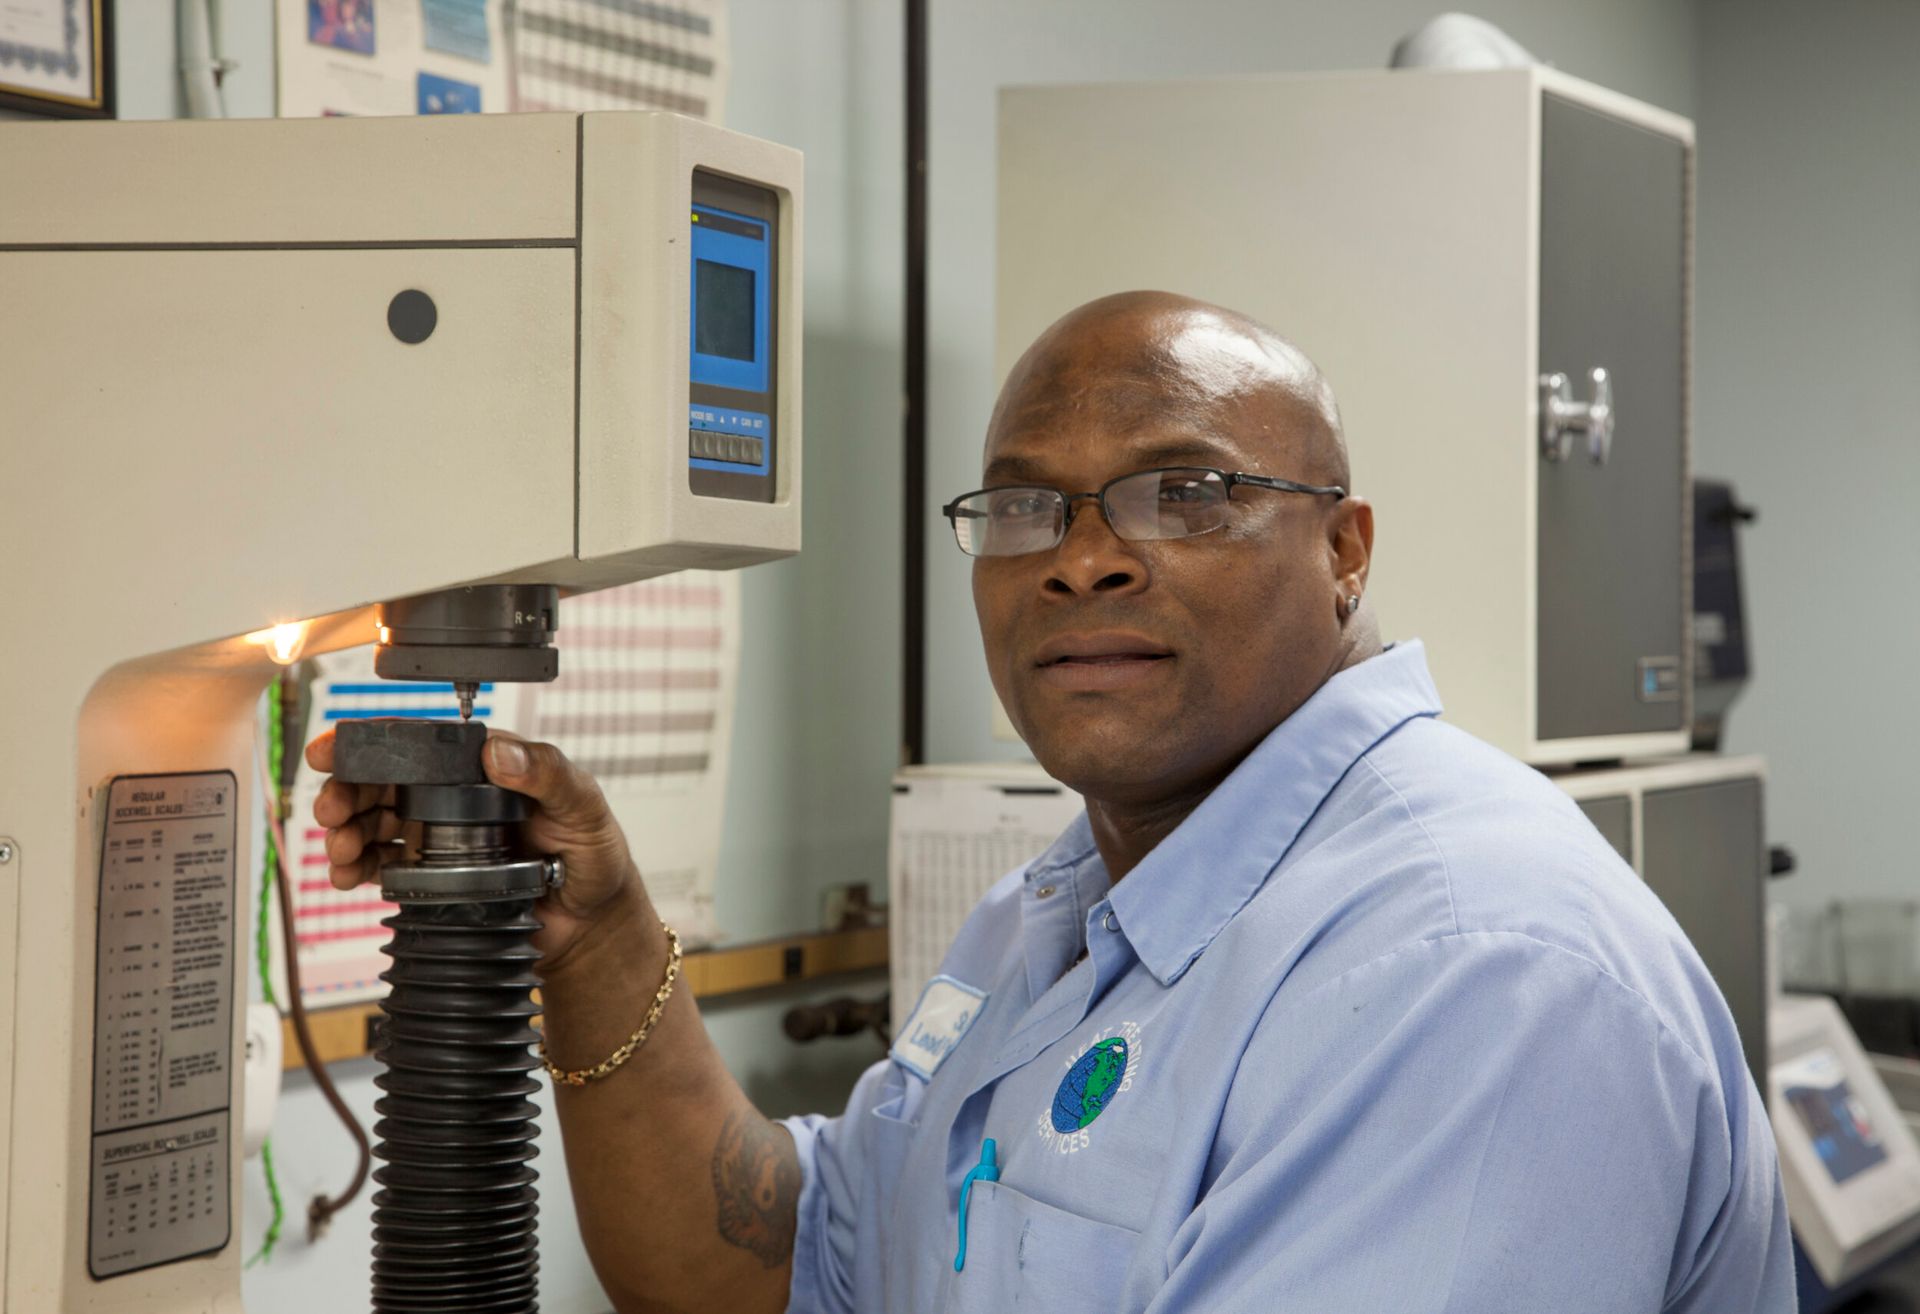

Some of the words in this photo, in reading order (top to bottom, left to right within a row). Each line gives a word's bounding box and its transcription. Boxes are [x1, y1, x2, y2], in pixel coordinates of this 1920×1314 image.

[514, 611, 523, 625] R
[132, 790, 165, 802] REGULAR
[155, 803, 183, 815] SCALES
